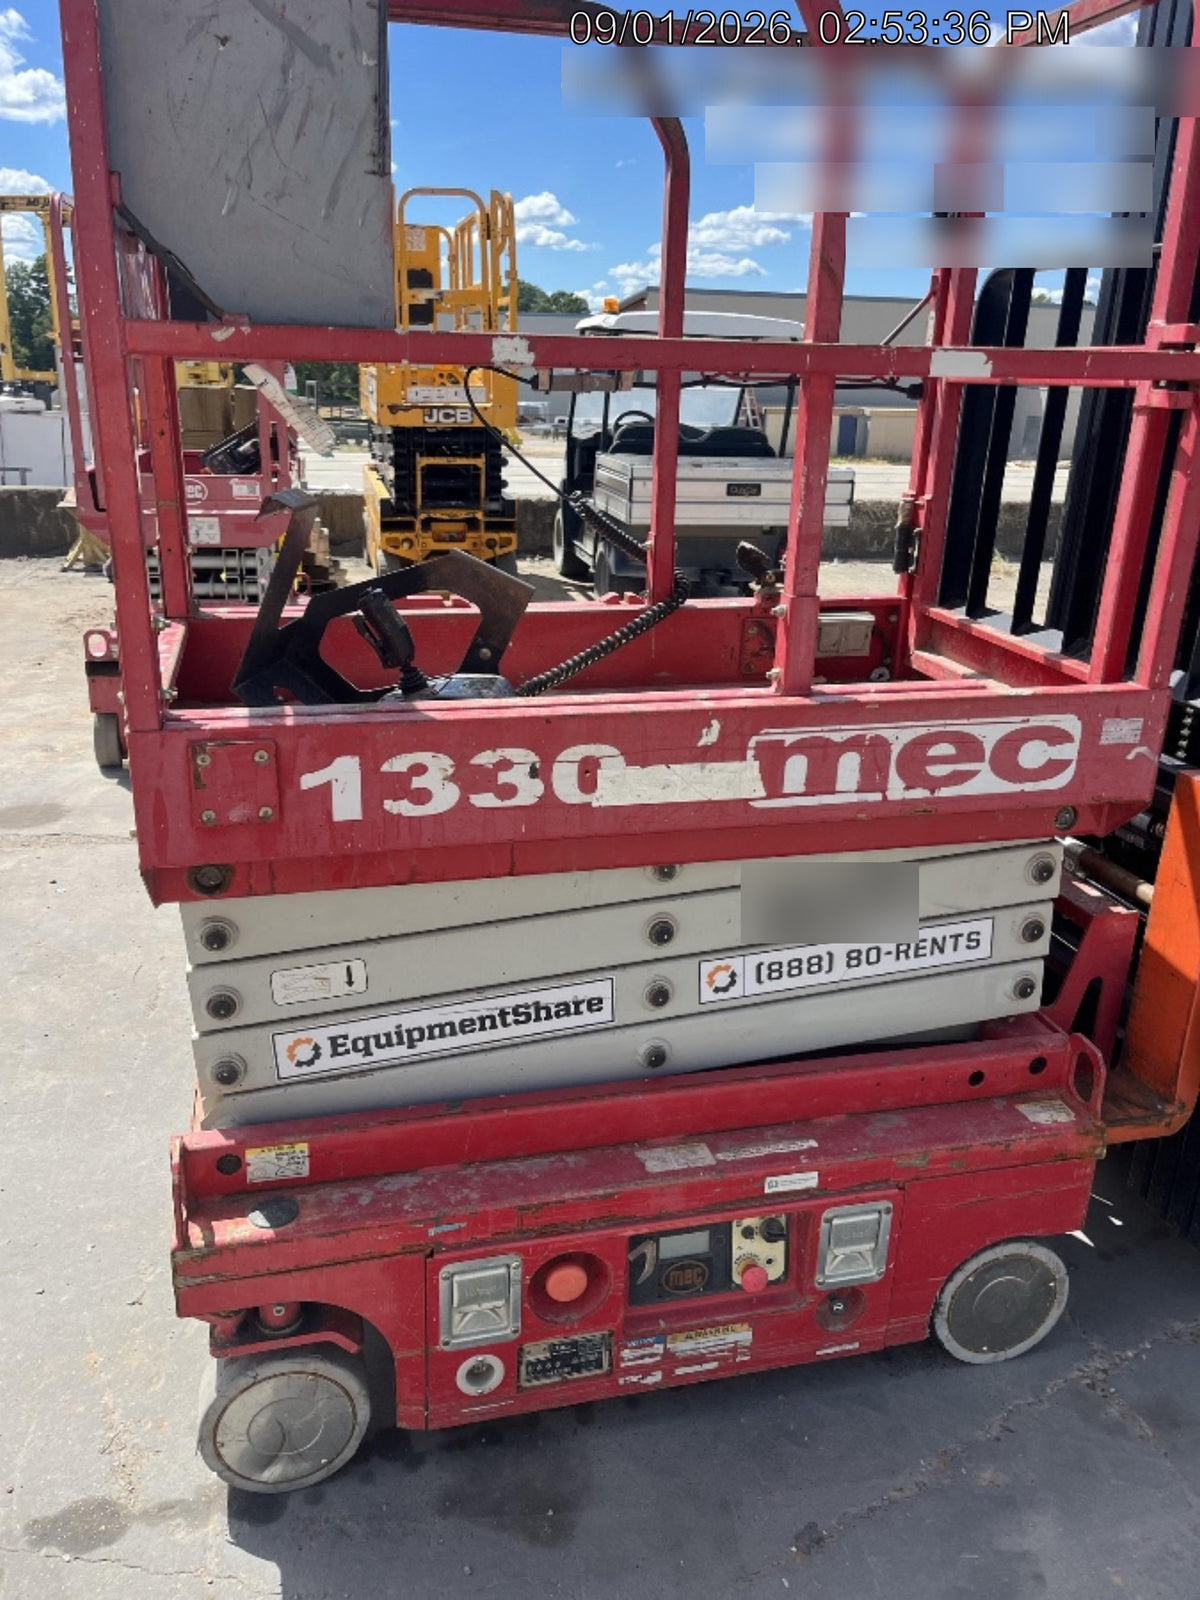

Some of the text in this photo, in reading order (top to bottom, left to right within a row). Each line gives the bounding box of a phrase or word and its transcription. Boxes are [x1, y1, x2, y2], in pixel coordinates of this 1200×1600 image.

[424, 407, 473, 424] JCB
[300, 744, 627, 822] 1330
[756, 930, 981, 985] (888) 80-RENTS
[328, 996, 604, 1058] EquipmentShare
